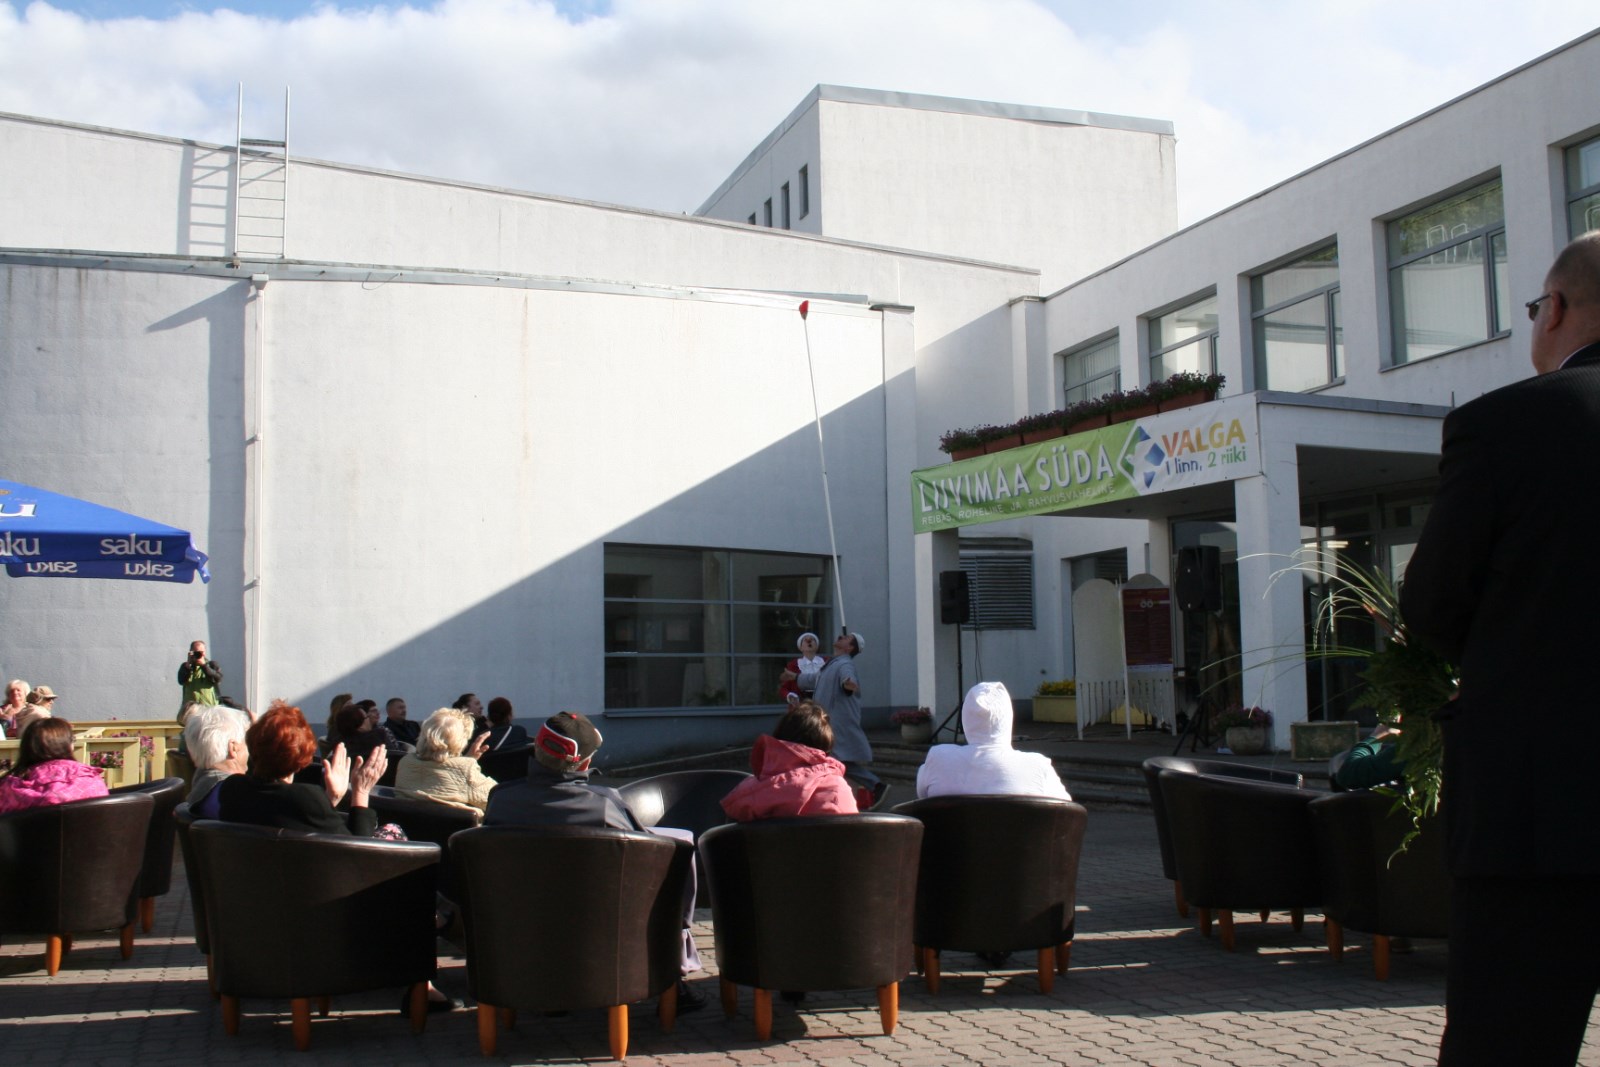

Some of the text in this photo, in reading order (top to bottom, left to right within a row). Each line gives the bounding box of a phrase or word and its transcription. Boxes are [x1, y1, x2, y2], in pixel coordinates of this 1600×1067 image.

[1161, 417, 1246, 458] VALGA
[1174, 457, 1203, 474] linn,
[1207, 451, 1217, 468] 2
[1221, 445, 1247, 465] riiki
[919, 444, 1115, 512] LIIVIMAA SÜDA
[958, 503, 1004, 519] ROHELINE
[1010, 501, 1022, 511] JA
[100, 532, 163, 556] saku
